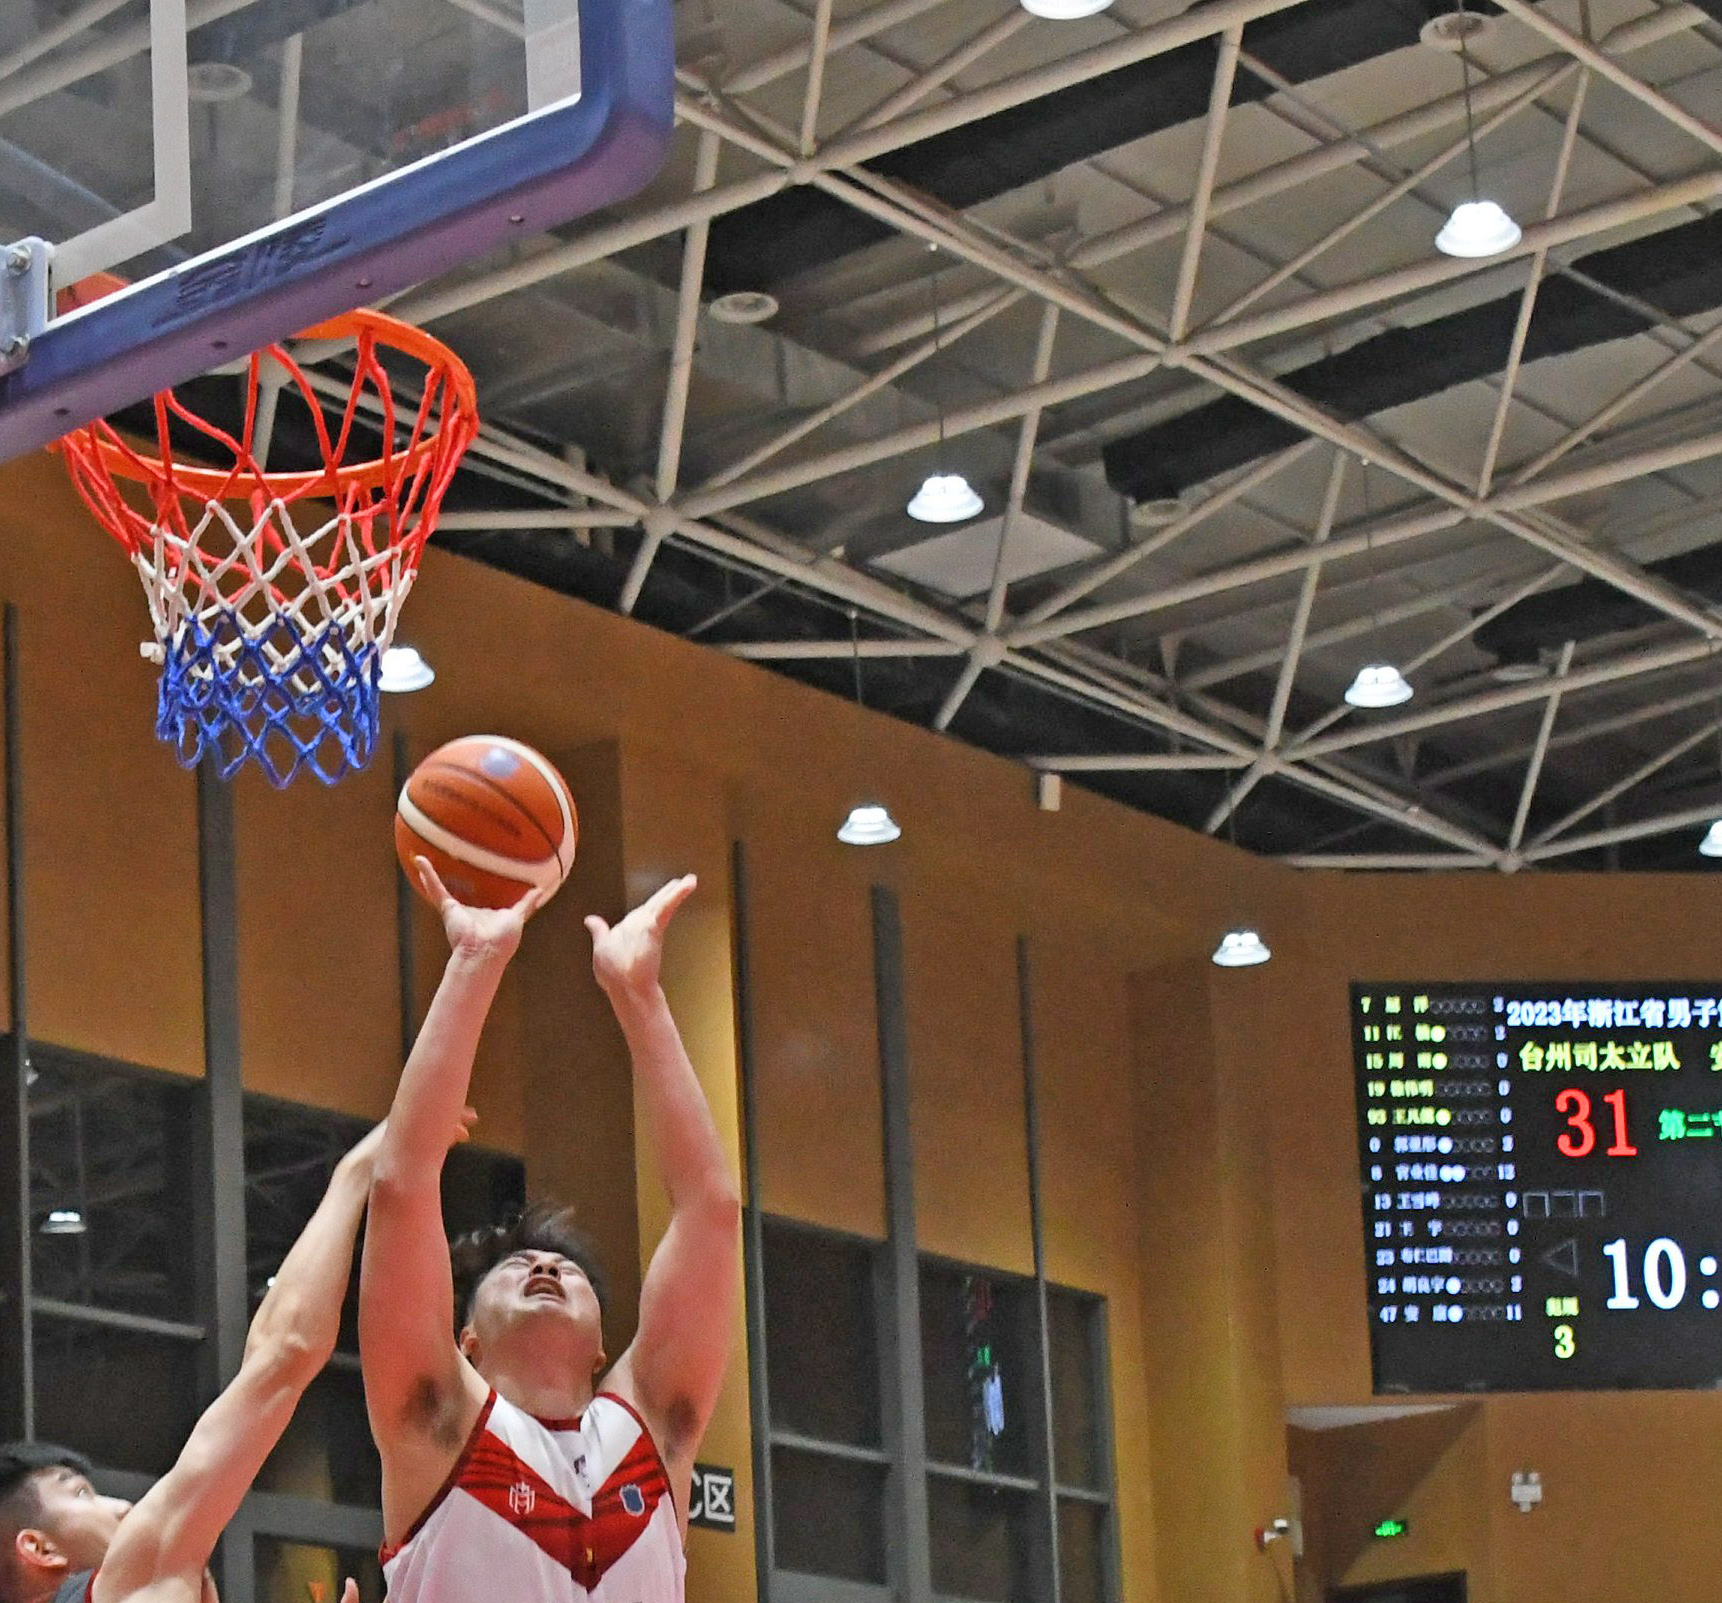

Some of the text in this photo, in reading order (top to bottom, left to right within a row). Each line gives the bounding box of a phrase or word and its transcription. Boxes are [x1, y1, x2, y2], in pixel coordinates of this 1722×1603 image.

[1518, 1041, 1680, 1072] 台州司太立队
[1554, 1088, 1638, 1157] 31
[1554, 1325, 1576, 1359] 3
